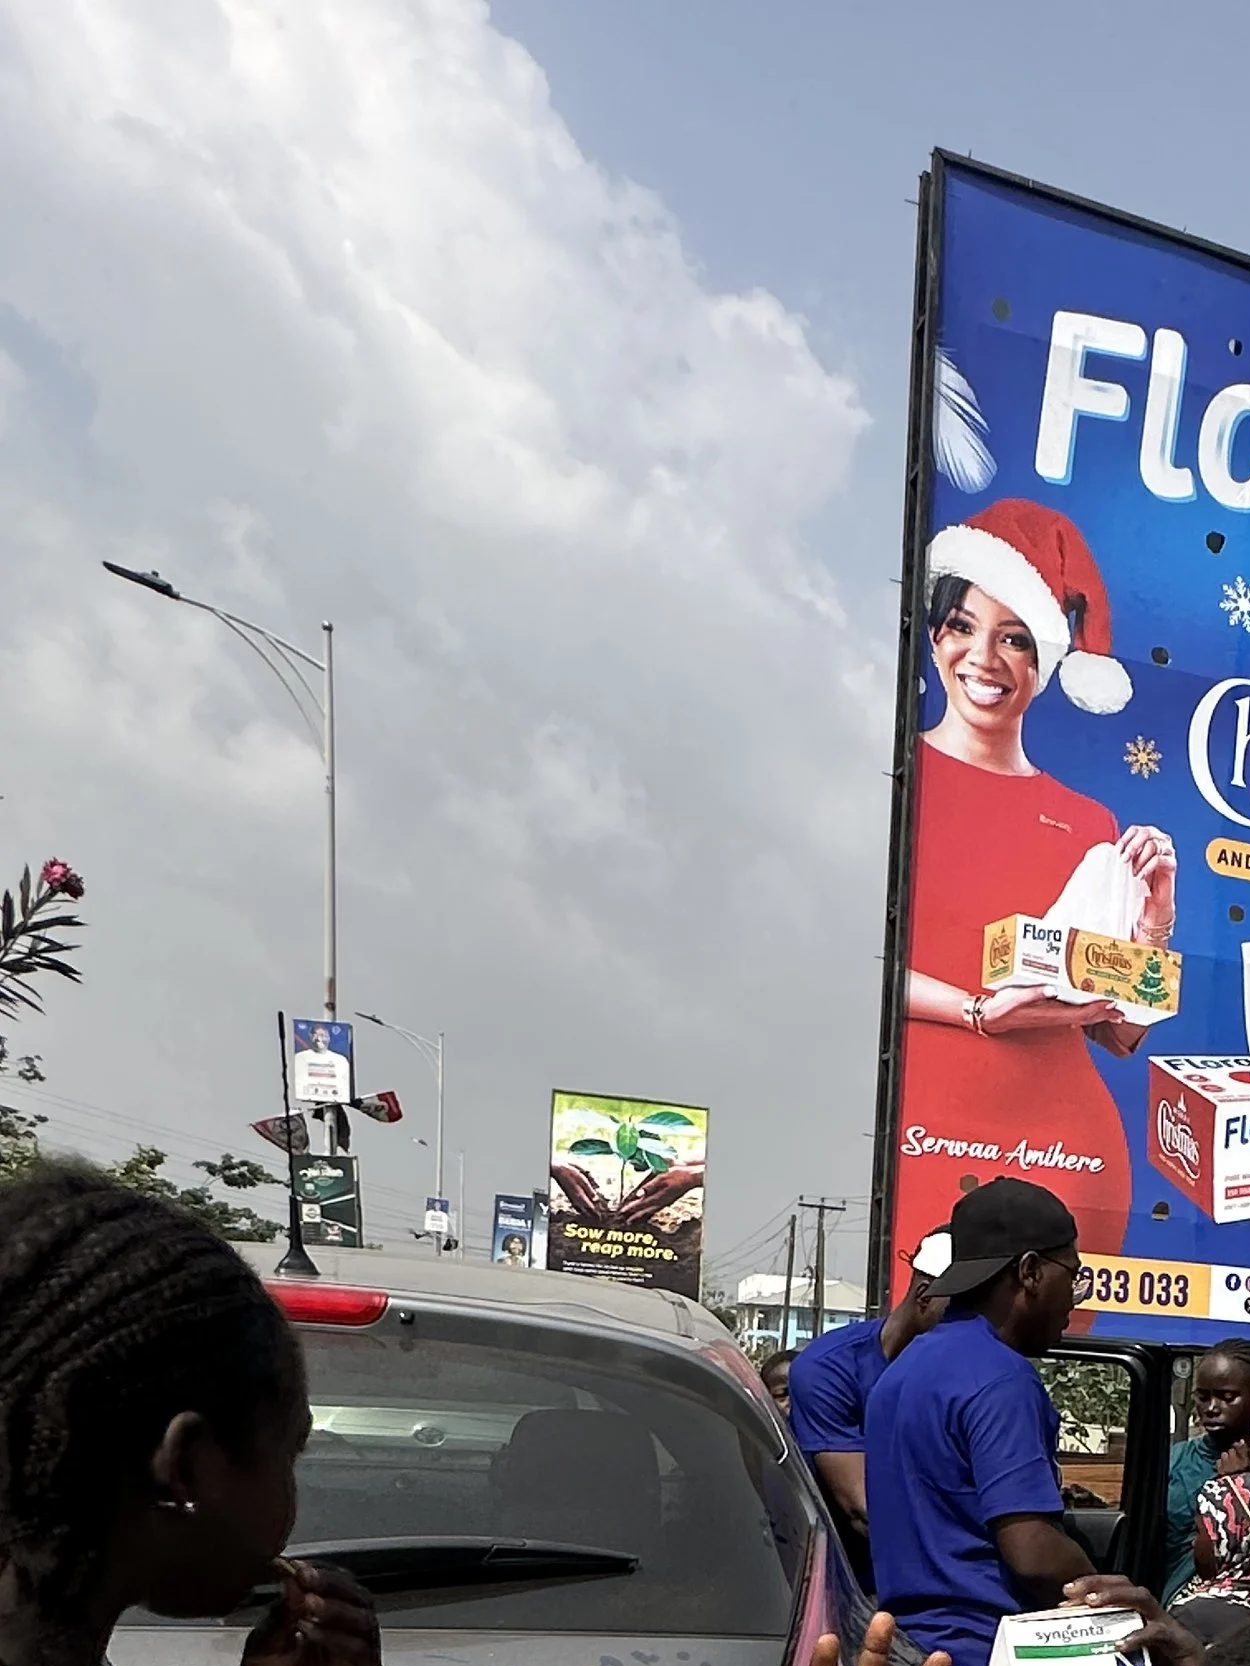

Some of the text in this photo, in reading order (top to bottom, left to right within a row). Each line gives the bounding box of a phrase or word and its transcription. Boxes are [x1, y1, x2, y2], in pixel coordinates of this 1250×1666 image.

[1022, 923, 1062, 942] Flora
[900, 1125, 1105, 1172] Serwaa Amihere
[563, 1223, 658, 1247] Sow more,
[581, 1241, 678, 1260] reap more.
[1138, 1271, 1189, 1307] 033
[1035, 1624, 1104, 1643] syngenta
